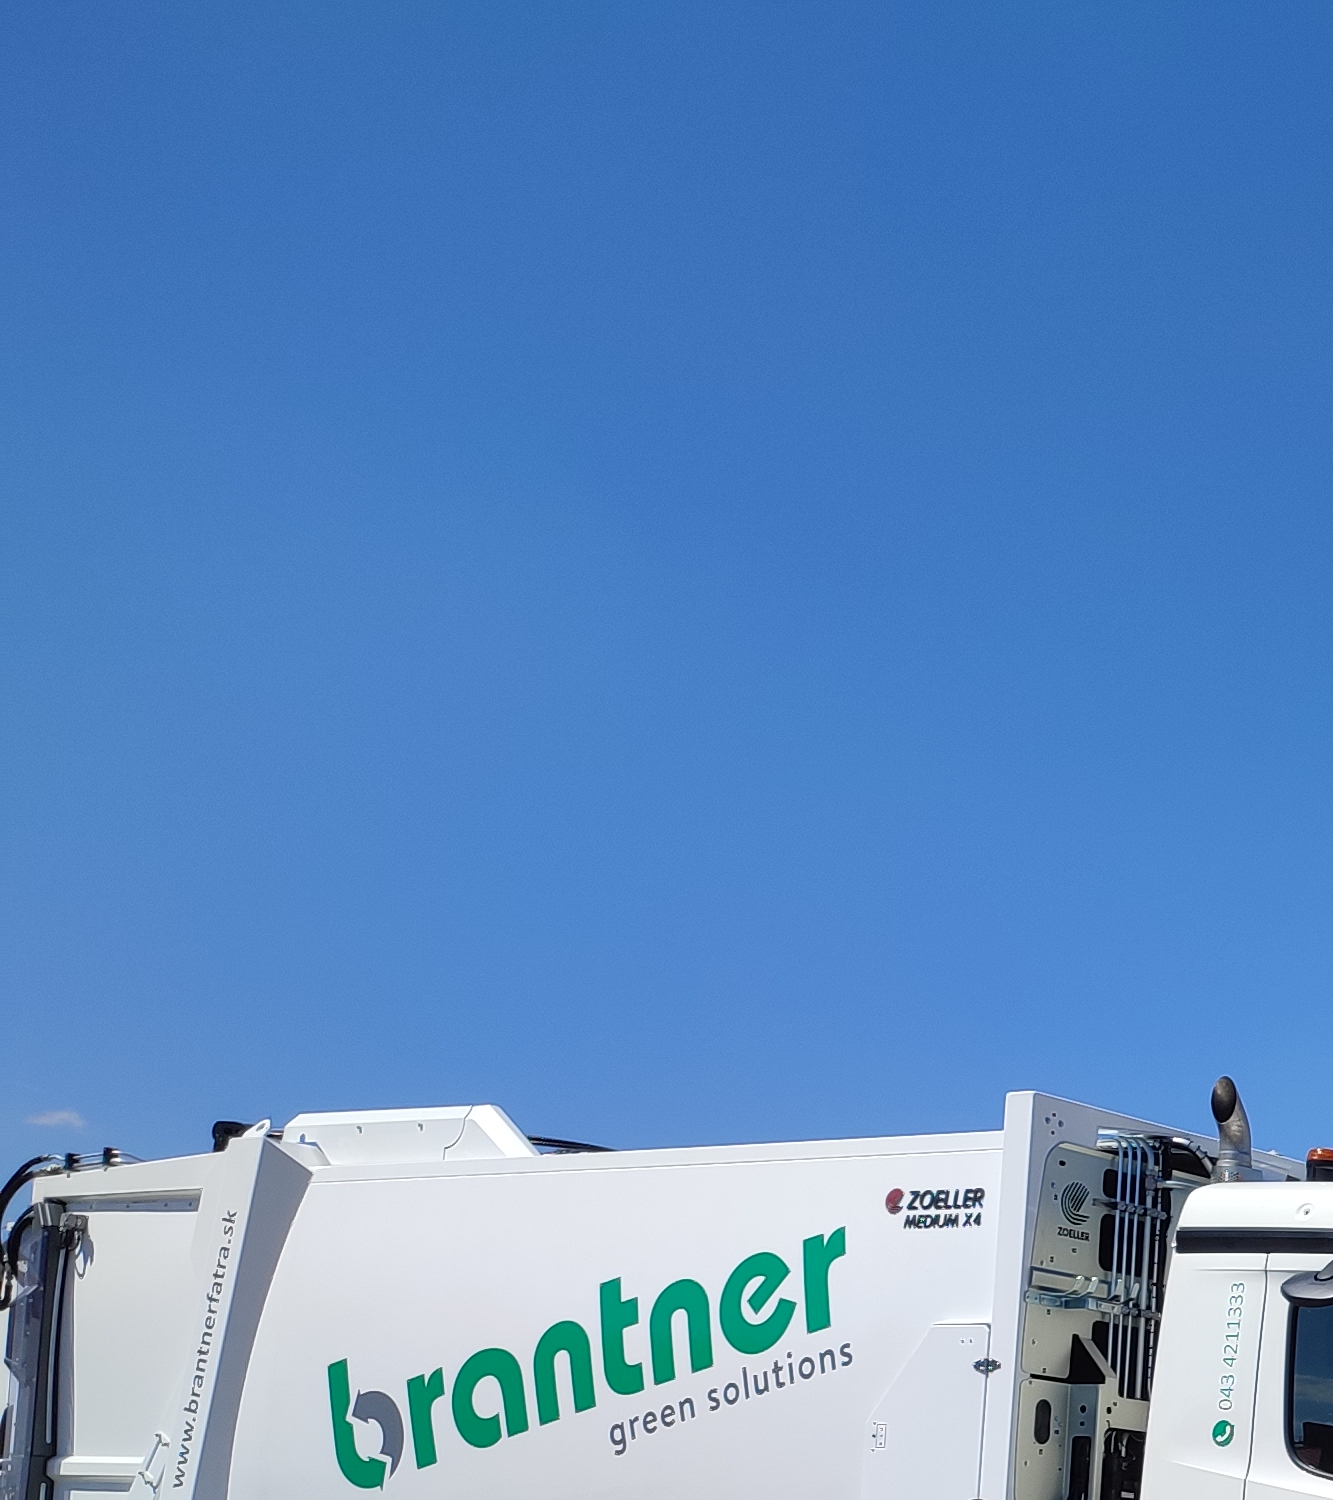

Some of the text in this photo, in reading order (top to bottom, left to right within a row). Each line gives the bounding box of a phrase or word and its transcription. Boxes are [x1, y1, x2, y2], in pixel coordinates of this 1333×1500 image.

[903, 1212, 982, 1229] MEDIUM X4
[906, 1187, 985, 1211] ZOELLER
[1057, 1226, 1090, 1242] ZOELLER
[172, 1209, 237, 1489] www.brantnerfatra.sk
[328, 1226, 846, 1491] brantner
[609, 1342, 853, 1456] green solutions
[1218, 1282, 1245, 1411] 043 4211333
